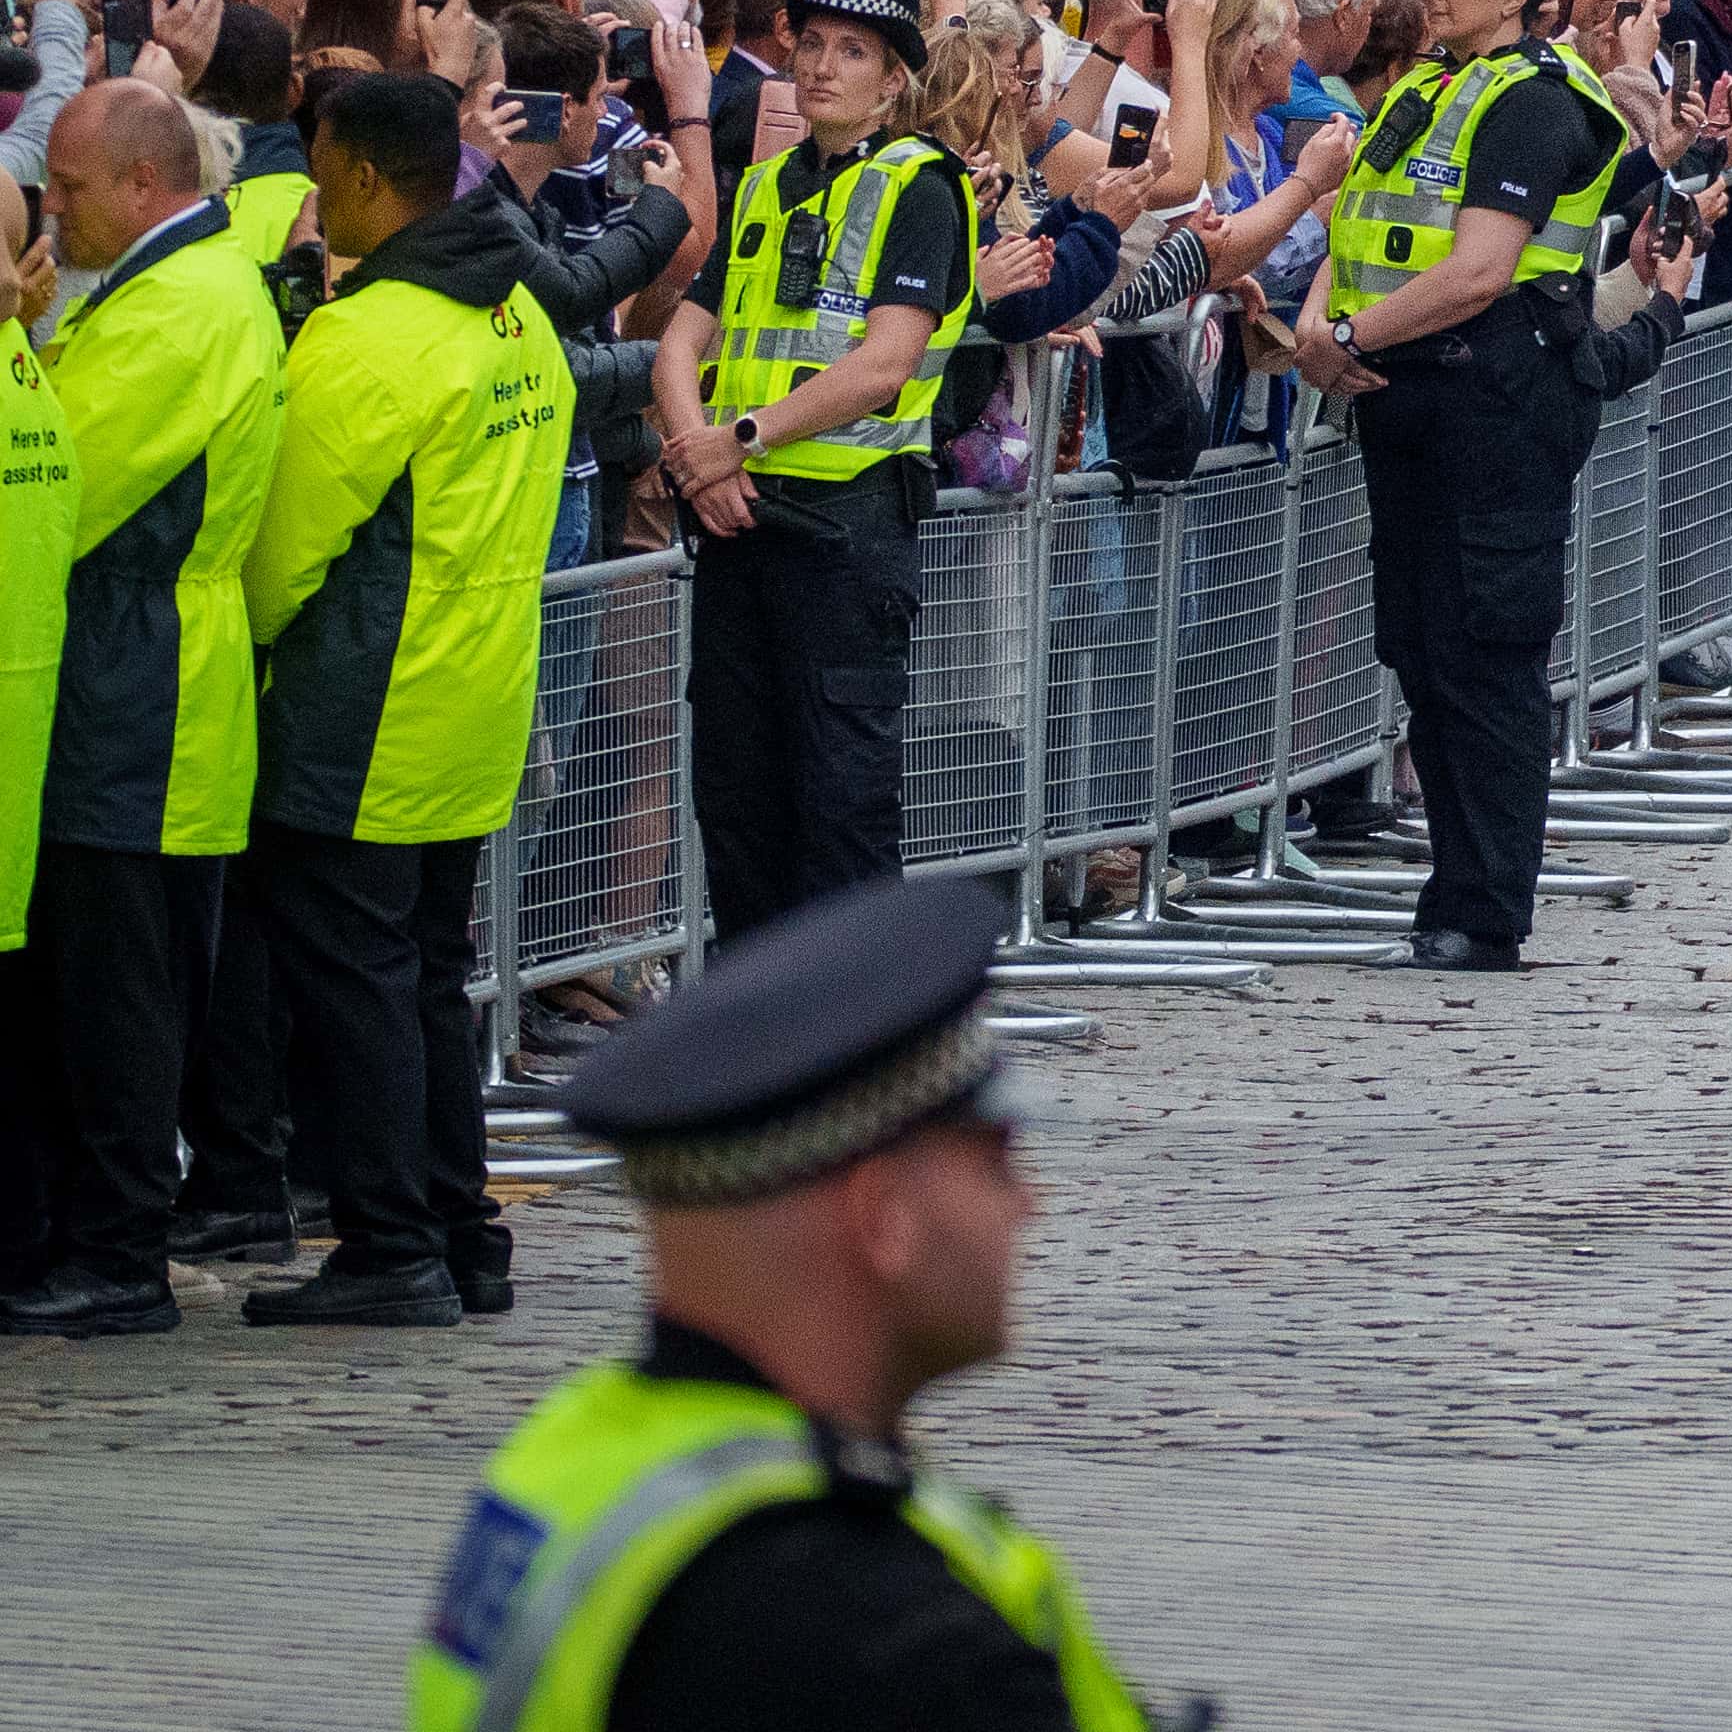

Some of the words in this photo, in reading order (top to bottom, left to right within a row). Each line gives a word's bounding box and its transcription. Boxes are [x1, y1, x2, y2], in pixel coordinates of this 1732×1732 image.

[1407, 160, 1459, 185] POLICE
[895, 275, 927, 289] POLICE
[816, 291, 866, 316] OLICE
[10, 428, 40, 450] Here
[42, 427, 57, 447] to
[2, 462, 43, 485] assist
[46, 464, 69, 487] you
